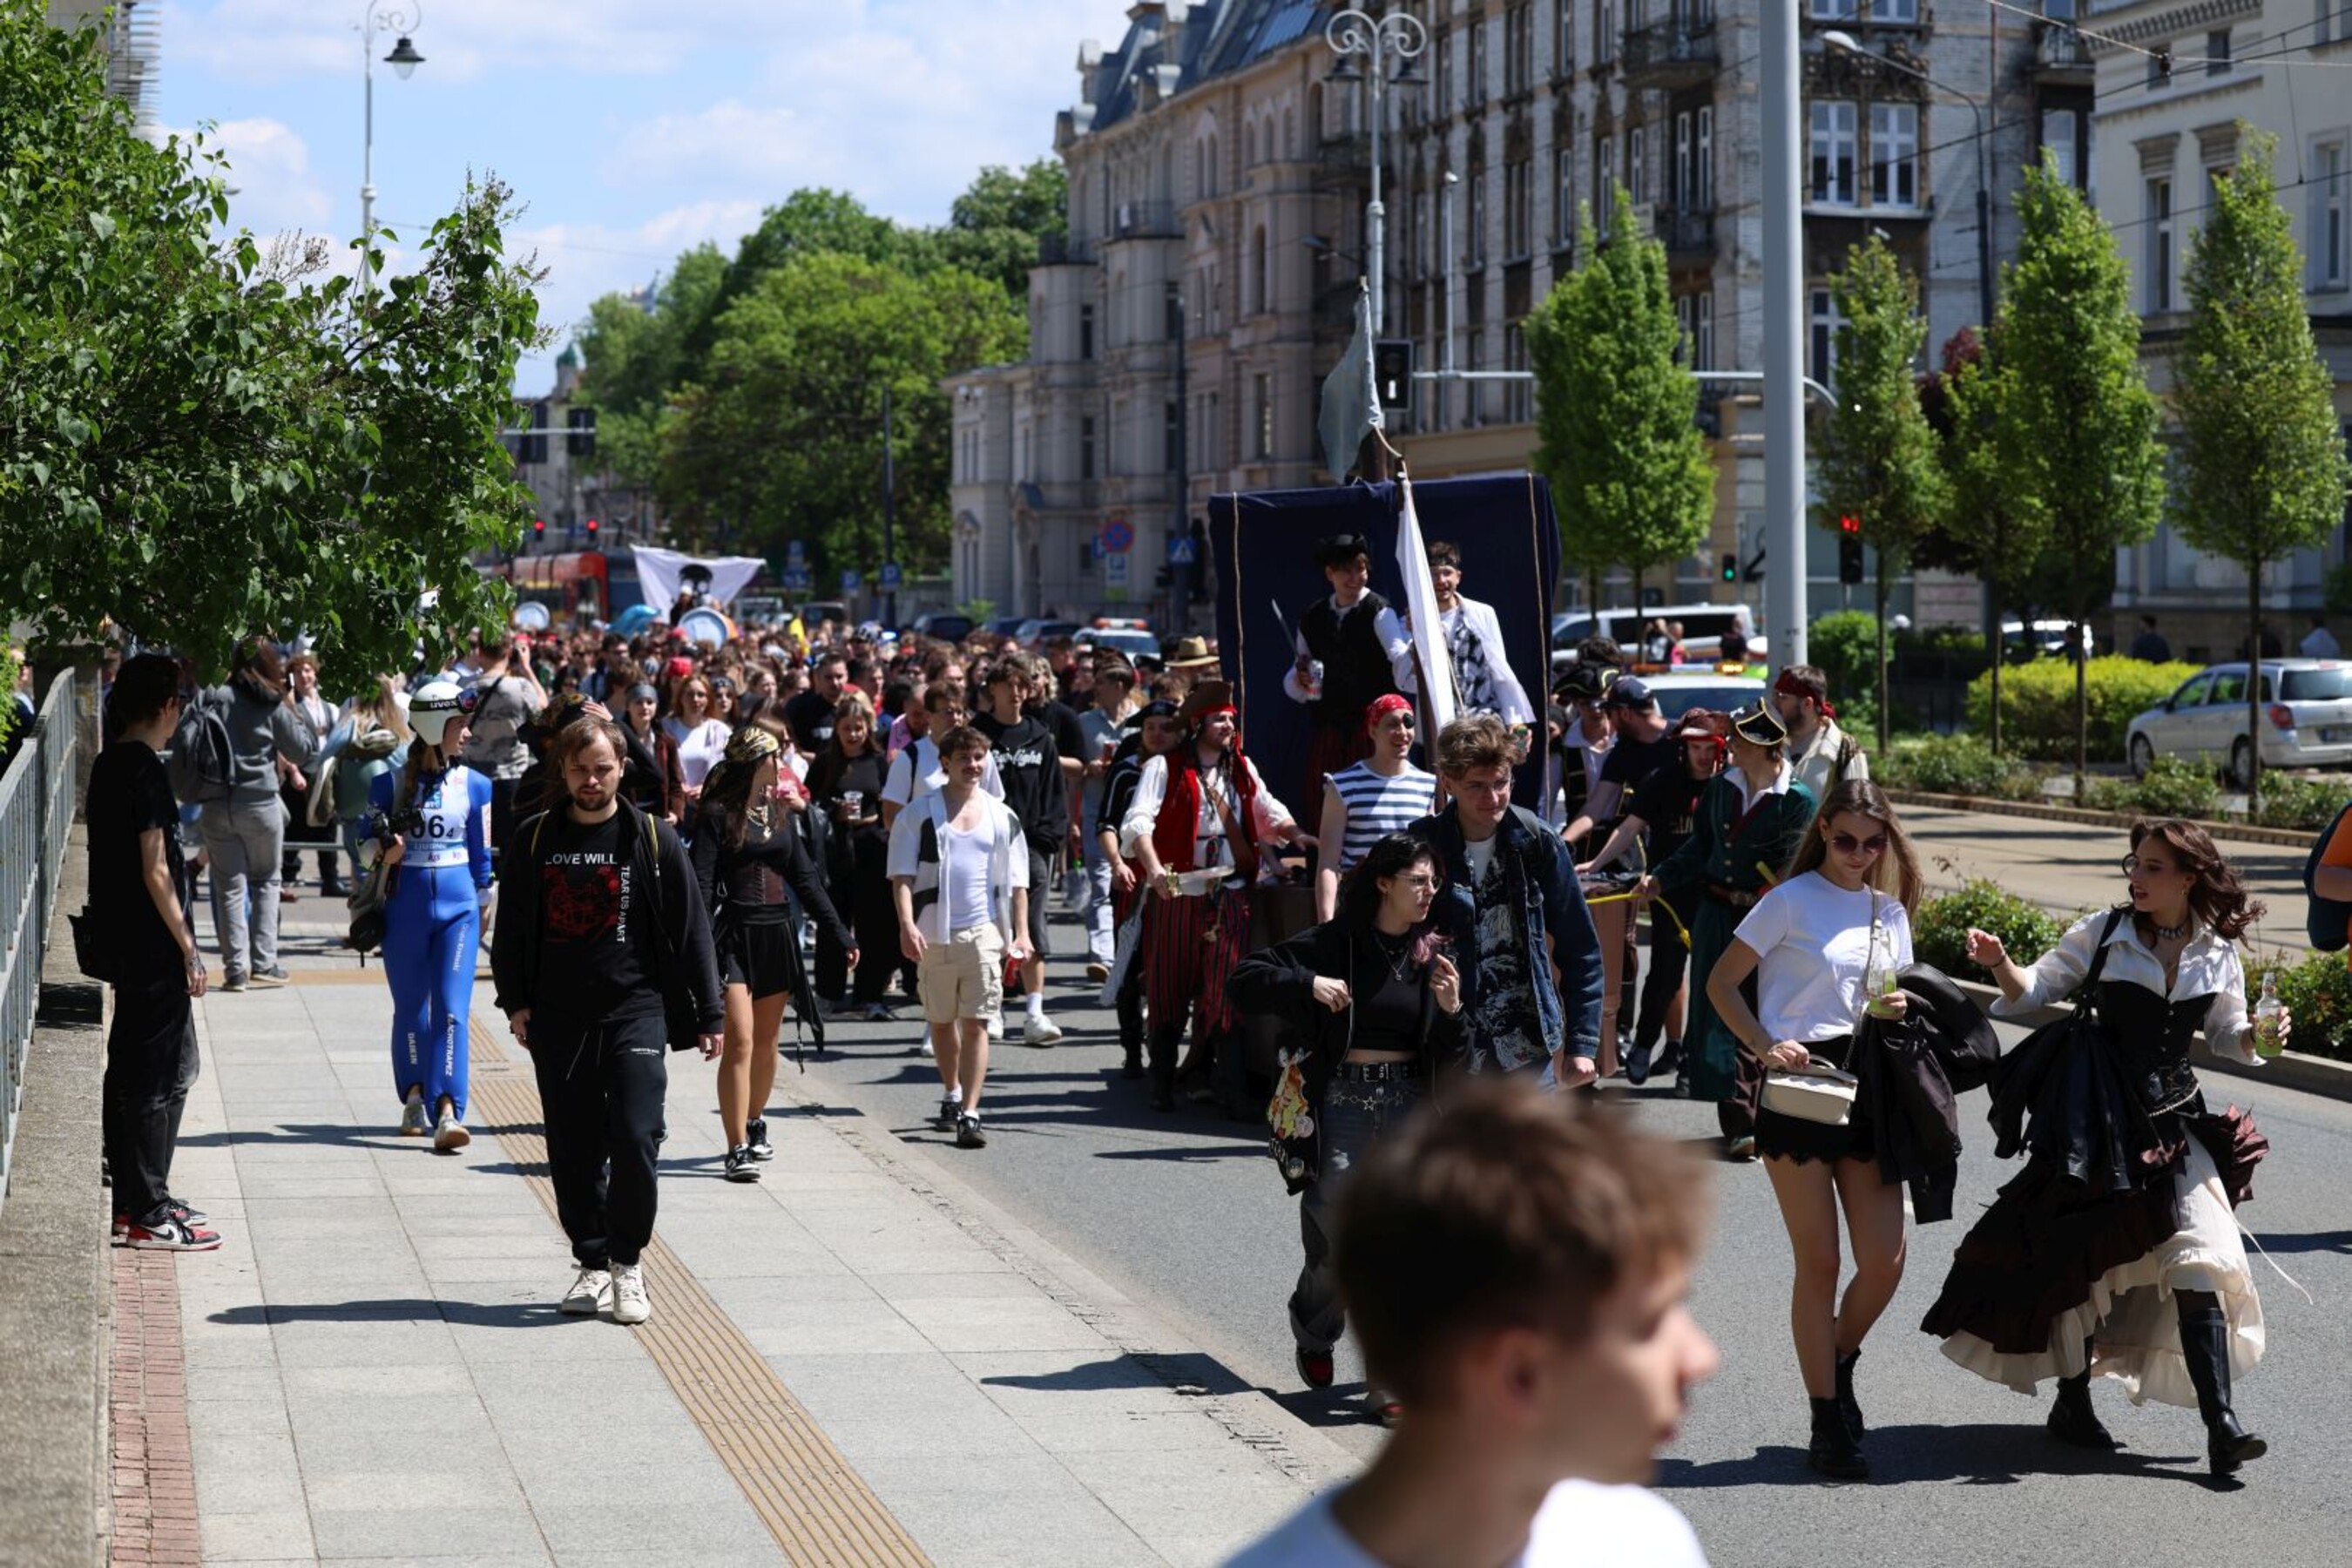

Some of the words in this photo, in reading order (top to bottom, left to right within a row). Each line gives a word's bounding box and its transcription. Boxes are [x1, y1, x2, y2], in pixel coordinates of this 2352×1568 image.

[545, 853, 581, 865] LOVE
[585, 853, 618, 865] WILL
[621, 866, 630, 894] TEAR
[620, 896, 630, 909] US
[617, 911, 627, 943] APART
